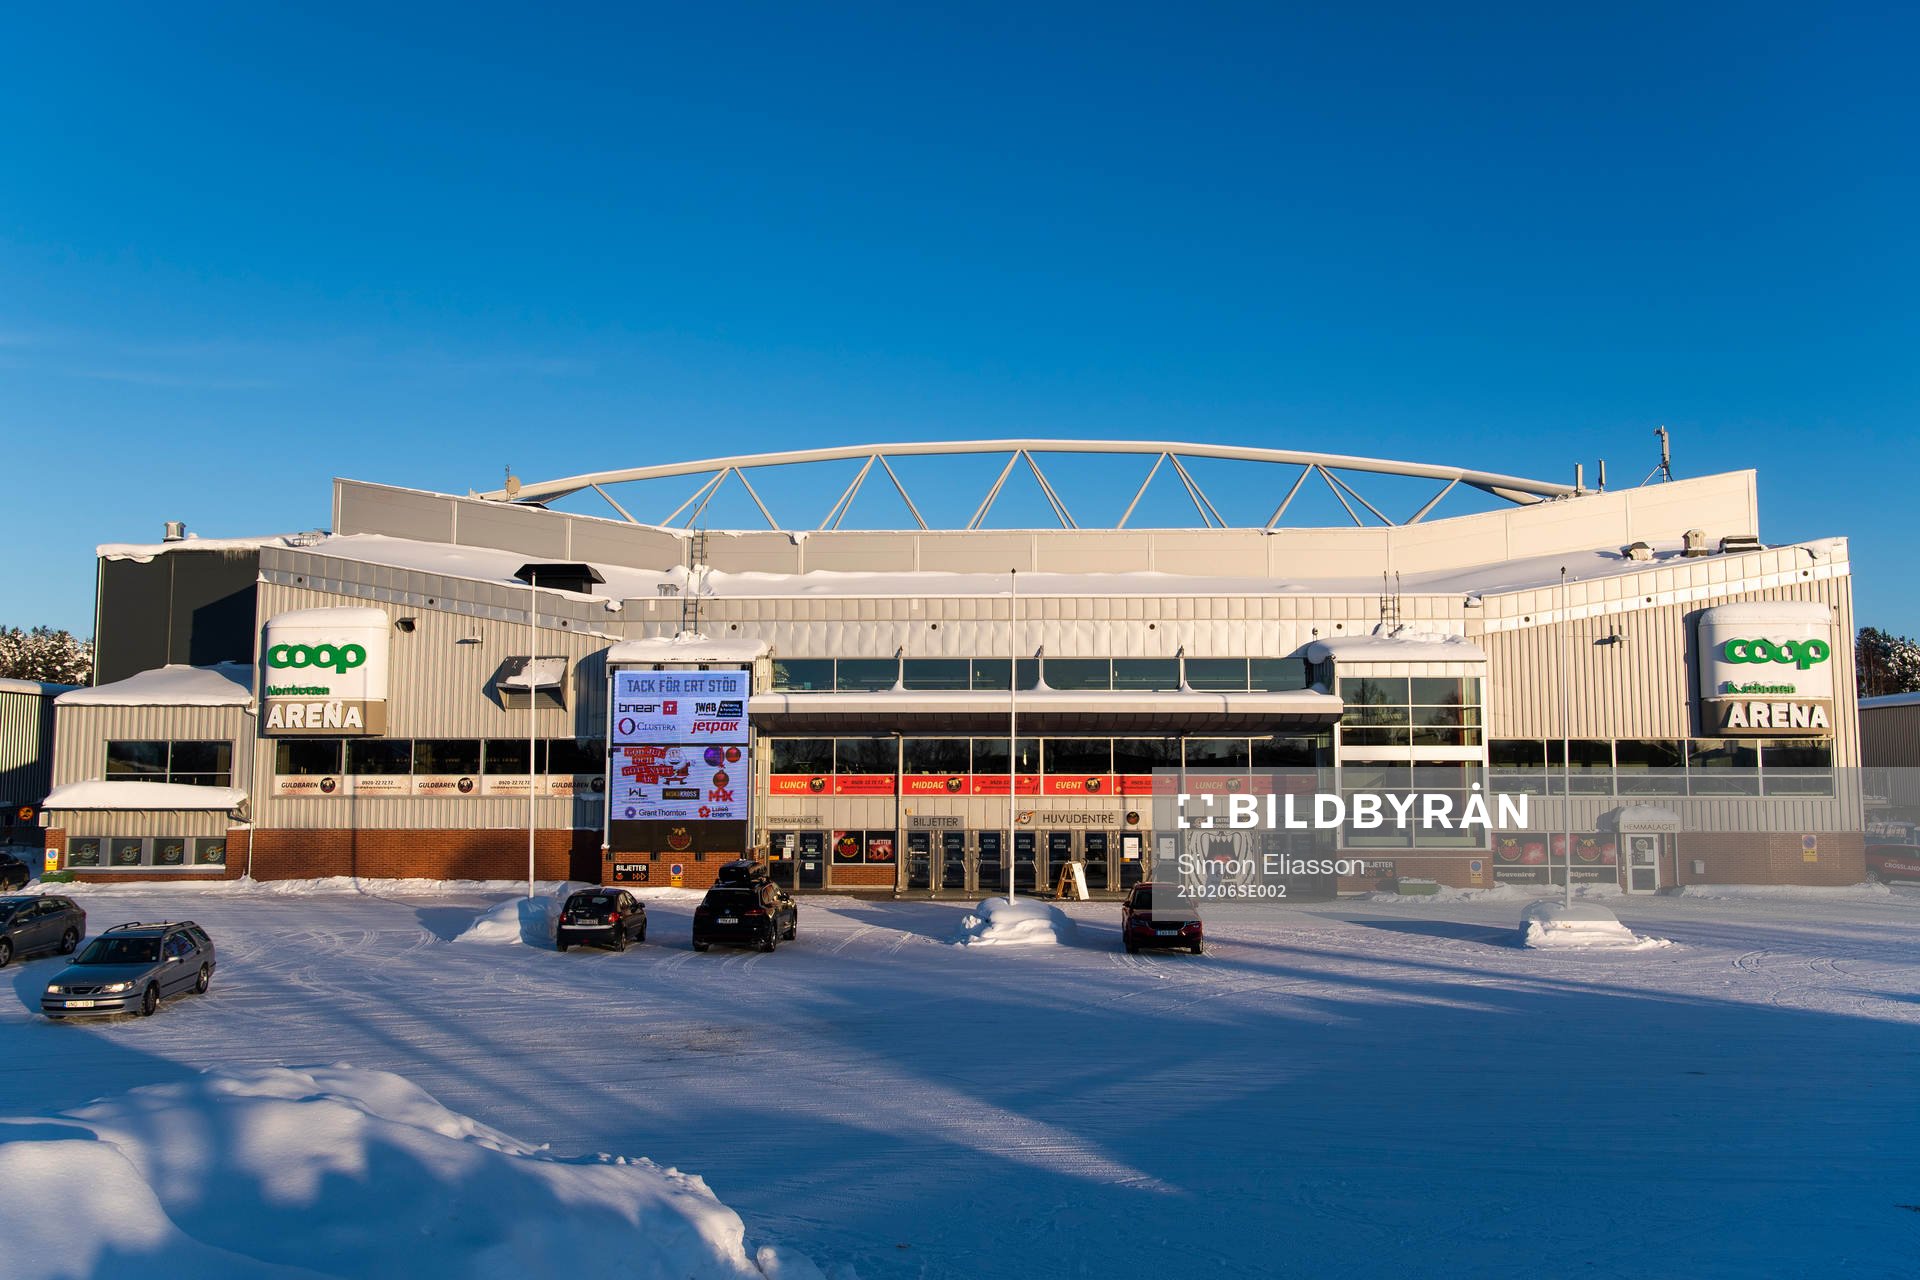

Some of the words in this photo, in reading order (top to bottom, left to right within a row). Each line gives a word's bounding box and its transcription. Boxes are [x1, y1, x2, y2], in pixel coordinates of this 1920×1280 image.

[267, 643, 367, 674] coop
[1725, 639, 1830, 670] coop
[627, 680, 655, 692] TACK
[660, 676, 680, 692] FÖR
[684, 680, 705, 692] ERT
[708, 676, 737, 692] STÖD
[266, 702, 363, 728] ARENA
[1727, 701, 1830, 728] ARENA
[691, 721, 740, 734] jetpak
[780, 781, 808, 789] LUNCH
[912, 781, 944, 789] MIDDAG
[1056, 781, 1083, 789] EVENT
[1195, 781, 1223, 790] LUNCH
[913, 817, 959, 827] BILJETTER
[1042, 812, 1115, 824] HUVUDENTRÉ
[1624, 823, 1676, 831] HEMMALAGET
[616, 864, 647, 872] BILJETTER
